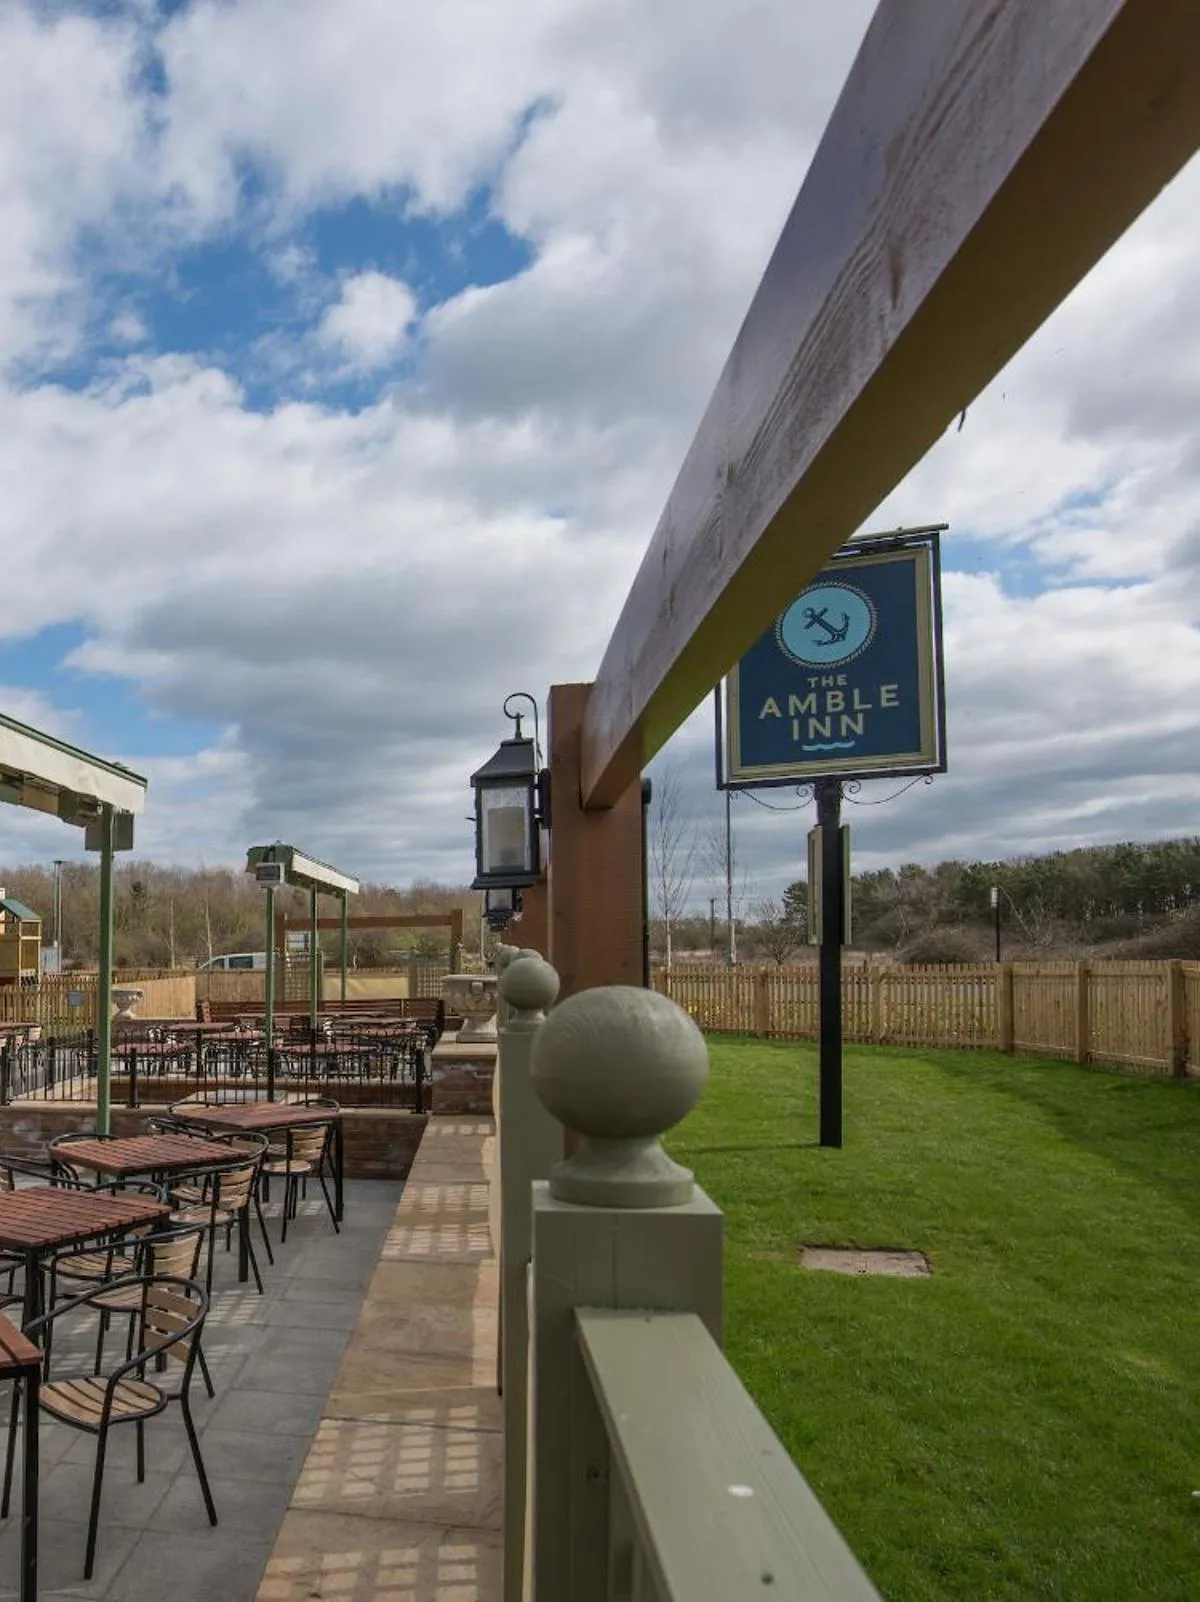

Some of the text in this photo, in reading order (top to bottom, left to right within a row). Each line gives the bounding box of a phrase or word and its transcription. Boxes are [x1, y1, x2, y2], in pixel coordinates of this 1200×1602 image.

[807, 675, 848, 689] THE
[758, 684, 900, 719] AMBLE
[792, 713, 864, 741] INN
